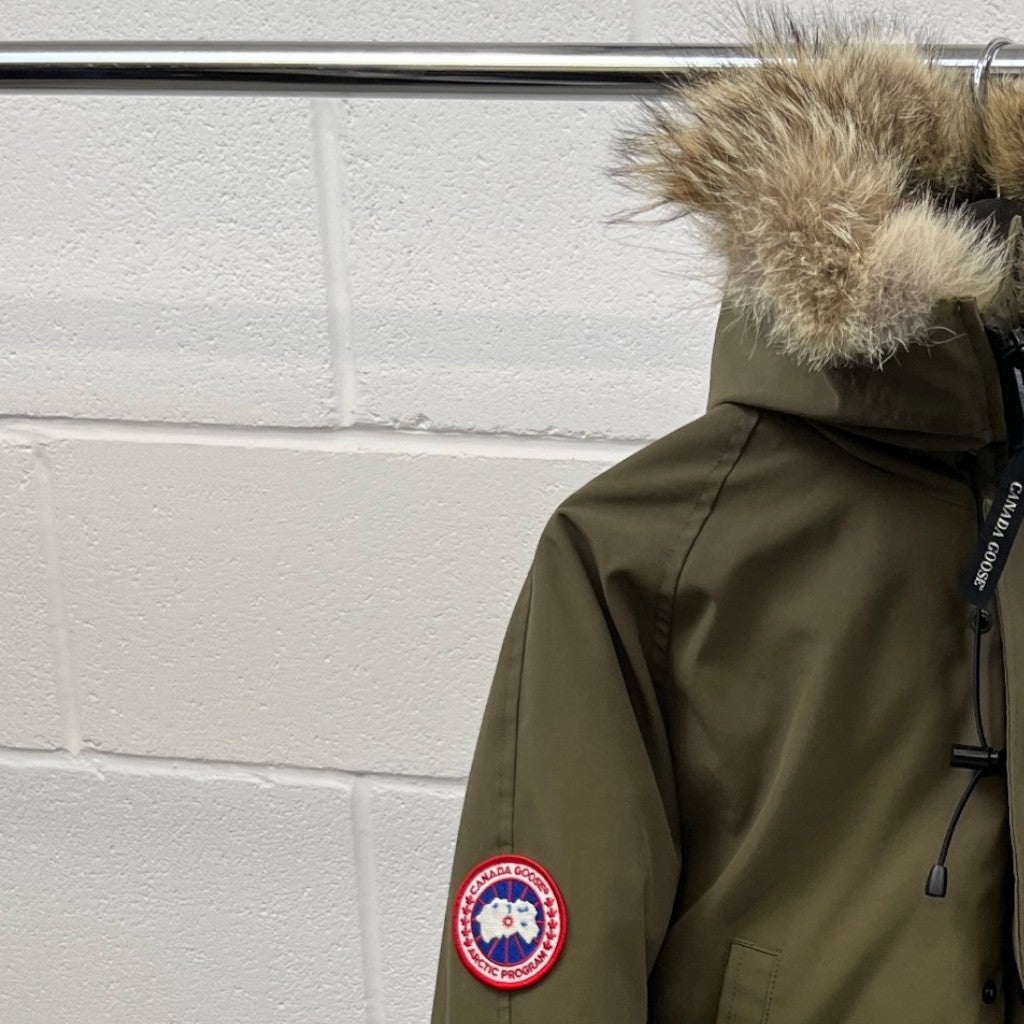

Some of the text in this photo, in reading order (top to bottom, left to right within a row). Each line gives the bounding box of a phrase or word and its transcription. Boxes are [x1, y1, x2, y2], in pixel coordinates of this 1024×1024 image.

[974, 481, 1023, 590] CANADA GOOSE
[470, 866, 512, 895] CANADA
[467, 948, 548, 979] ARCTIC PROGRAM
